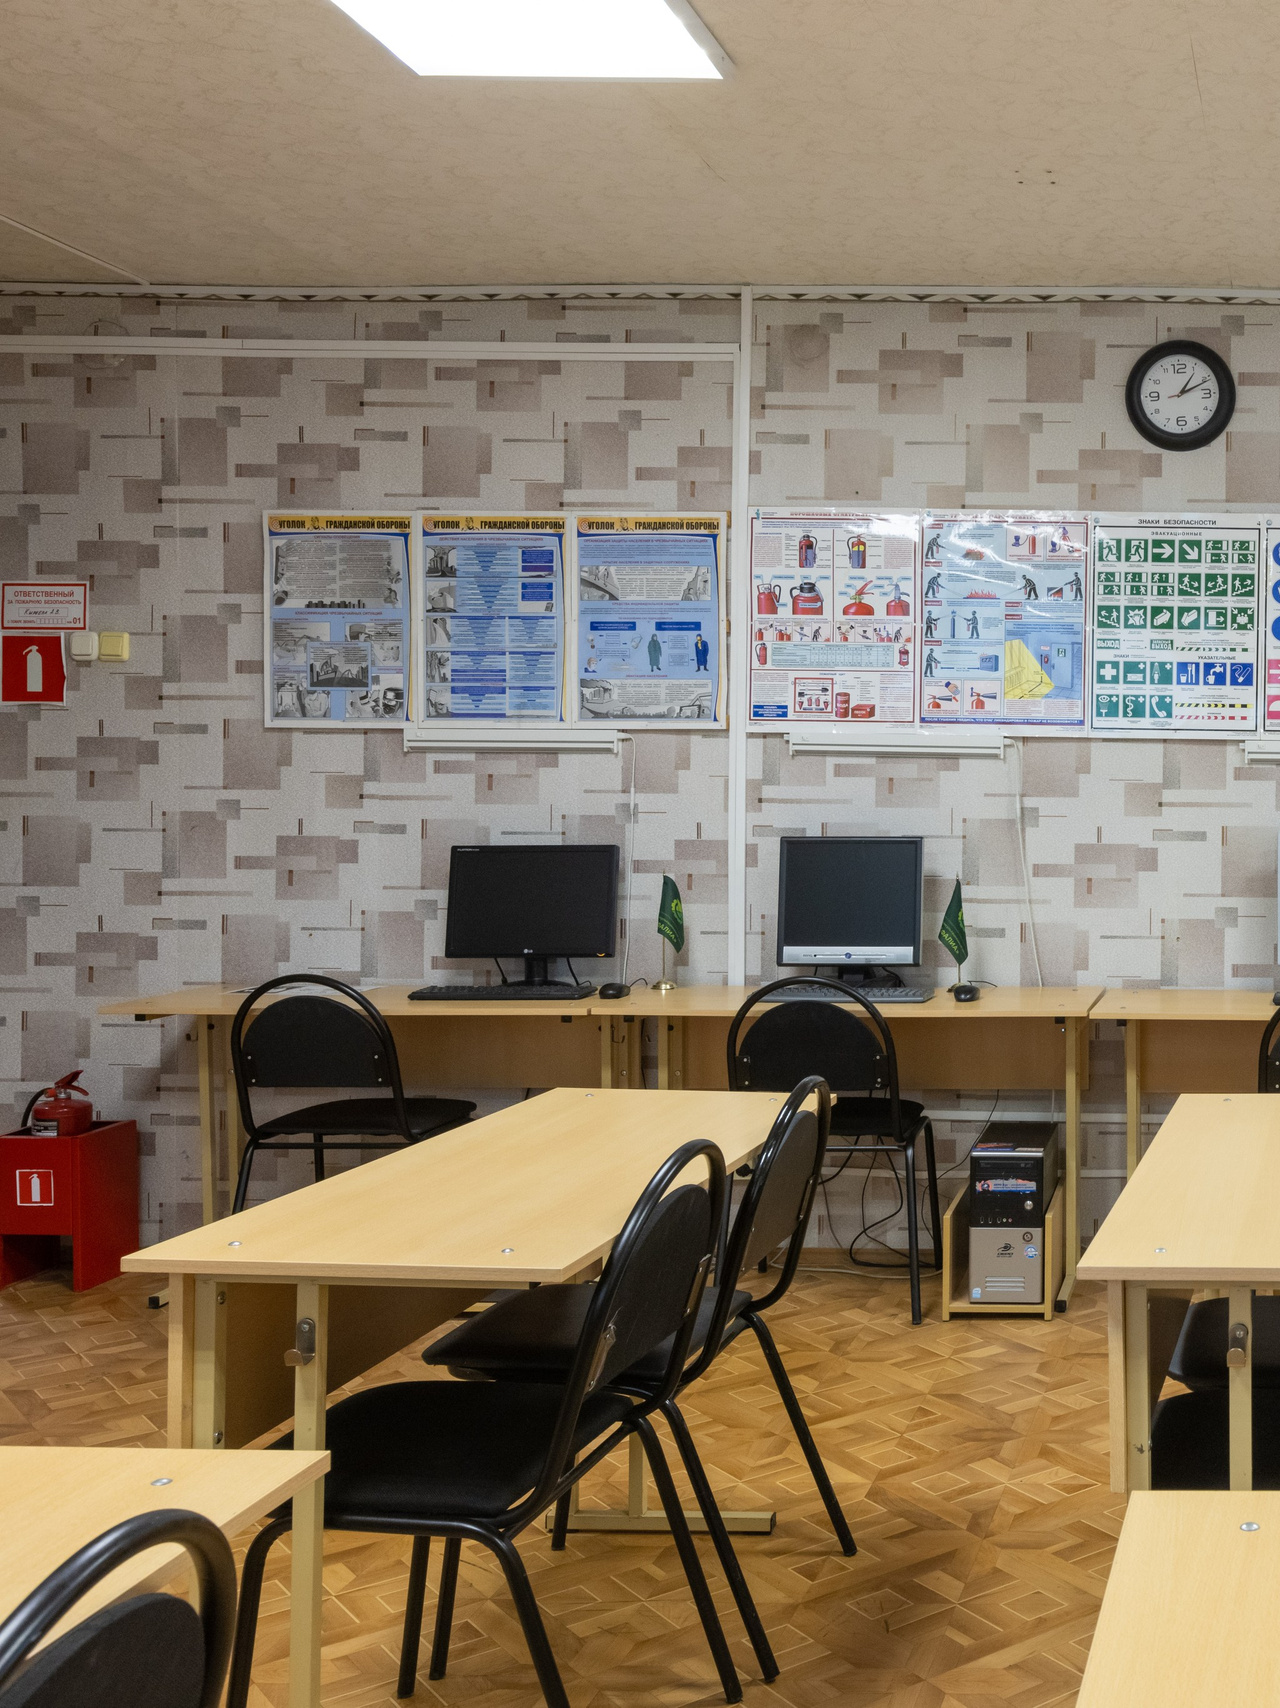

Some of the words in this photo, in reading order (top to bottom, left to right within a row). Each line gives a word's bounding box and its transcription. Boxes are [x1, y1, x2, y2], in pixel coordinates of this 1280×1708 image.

[1171, 364, 1186, 374] 12
[1149, 391, 1160, 401] 9
[1201, 389, 1212, 399] 3
[1176, 416, 1187, 427] 6
[279, 520, 306, 529] УГОЛОК
[326, 519, 375, 530] ГРАЖДАНСКОЙ
[376, 520, 410, 530] ОБОРОНЫ
[433, 520, 460, 530] УГОЛОК
[480, 519, 530, 530] ГРАЖДАНСКОЙ
[531, 520, 564, 530] ОБОРОНЫ
[588, 521, 614, 530] УГОЛОК
[635, 520, 684, 531] ГРАЖДАНСКОЙ
[686, 522, 719, 530] ОБОРОНЫ
[1097, 640, 1120, 649] ВЫХОД
